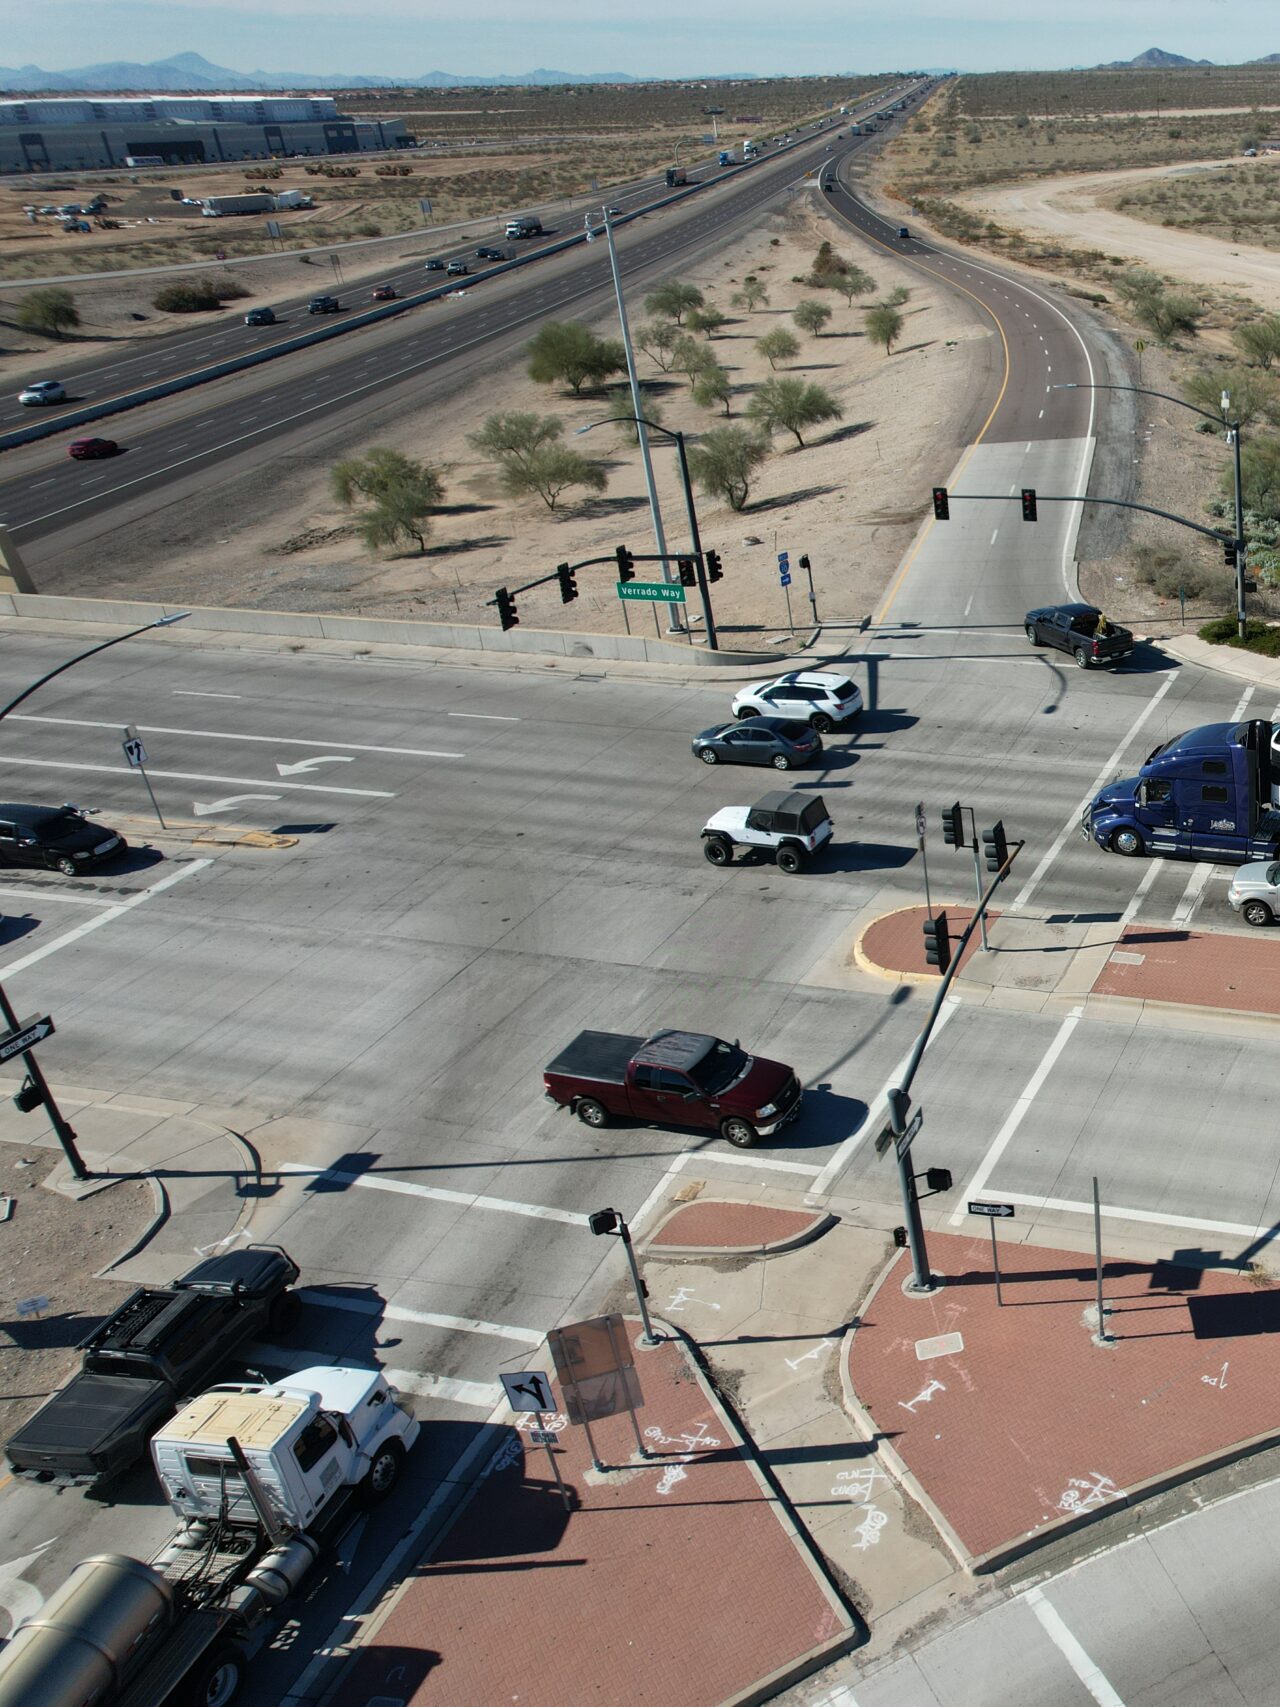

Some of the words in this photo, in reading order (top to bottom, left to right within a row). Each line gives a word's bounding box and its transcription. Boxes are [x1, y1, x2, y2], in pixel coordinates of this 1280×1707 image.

[621, 587, 657, 596] Verrado
[661, 589, 681, 599] Way
[4, 1042, 20, 1054] ONE
[22, 1031, 36, 1044] WAY
